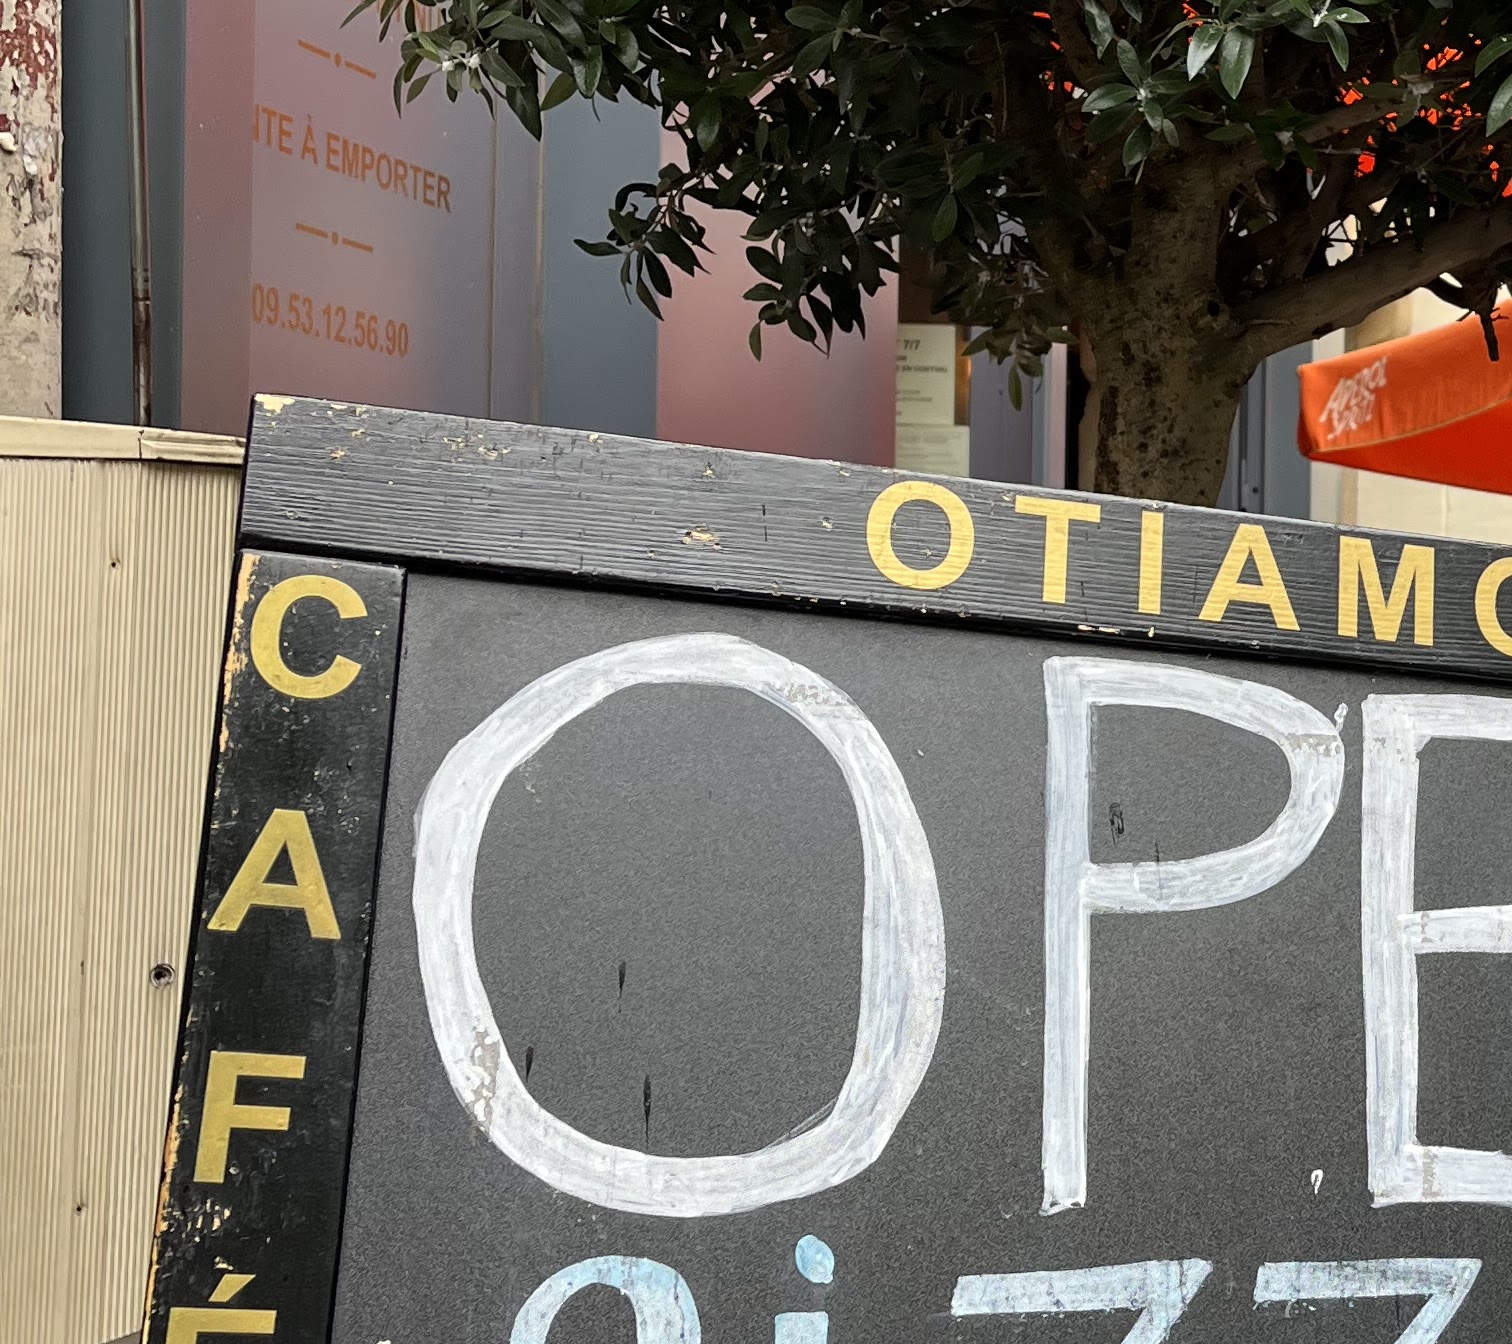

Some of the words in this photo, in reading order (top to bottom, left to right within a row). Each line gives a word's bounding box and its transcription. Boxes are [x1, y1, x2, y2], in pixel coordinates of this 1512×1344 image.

[301, 114, 319, 165] À
[325, 131, 452, 213] EMPORTER
[252, 282, 409, 358] 09.53.12.56.90
